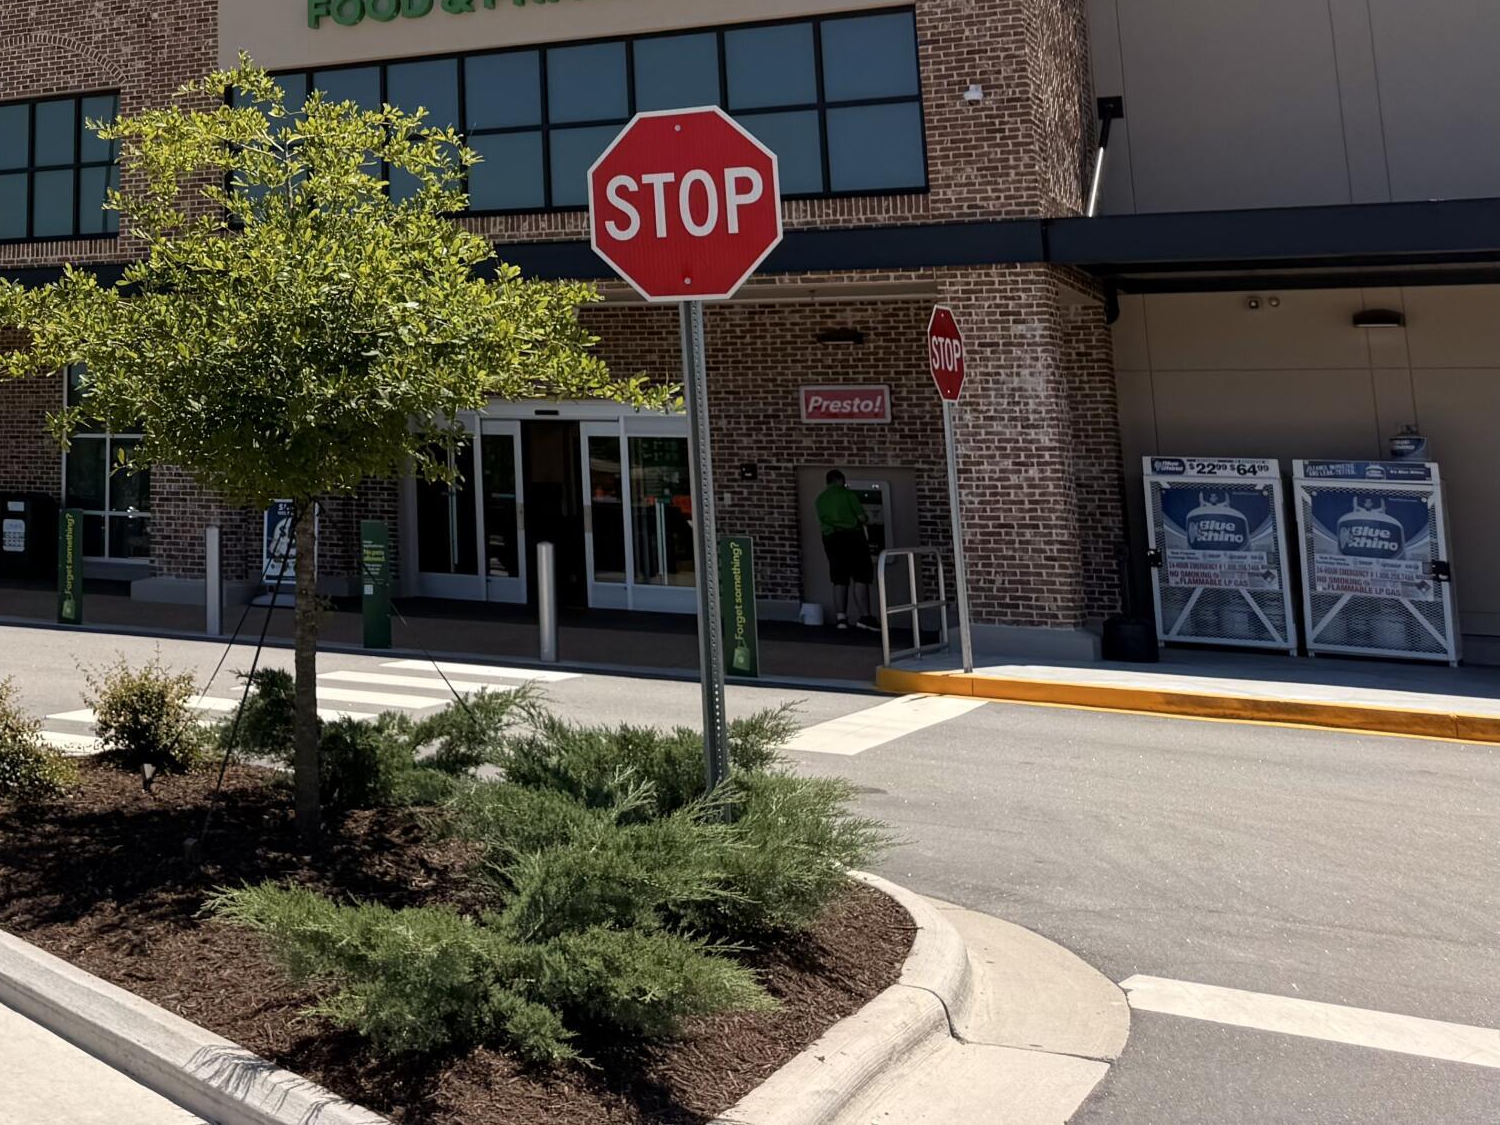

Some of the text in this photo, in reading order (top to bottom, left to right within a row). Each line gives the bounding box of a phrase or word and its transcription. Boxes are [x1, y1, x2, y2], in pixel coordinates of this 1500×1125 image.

[605, 166, 763, 241] STOP
[931, 335, 962, 372] STOP
[807, 395, 883, 413] Presto!
[1200, 520, 1236, 531] Blue
[1351, 525, 1391, 539] Blue
[1180, 571, 1212, 579] SMOKING
[1328, 577, 1363, 586] SMOKING
[1179, 578, 1221, 586] FLAMMABLE
[729, 541, 746, 640] Forget something?
[1327, 583, 1373, 593] FLAMMABLE
[1385, 588, 1401, 596] GAS
